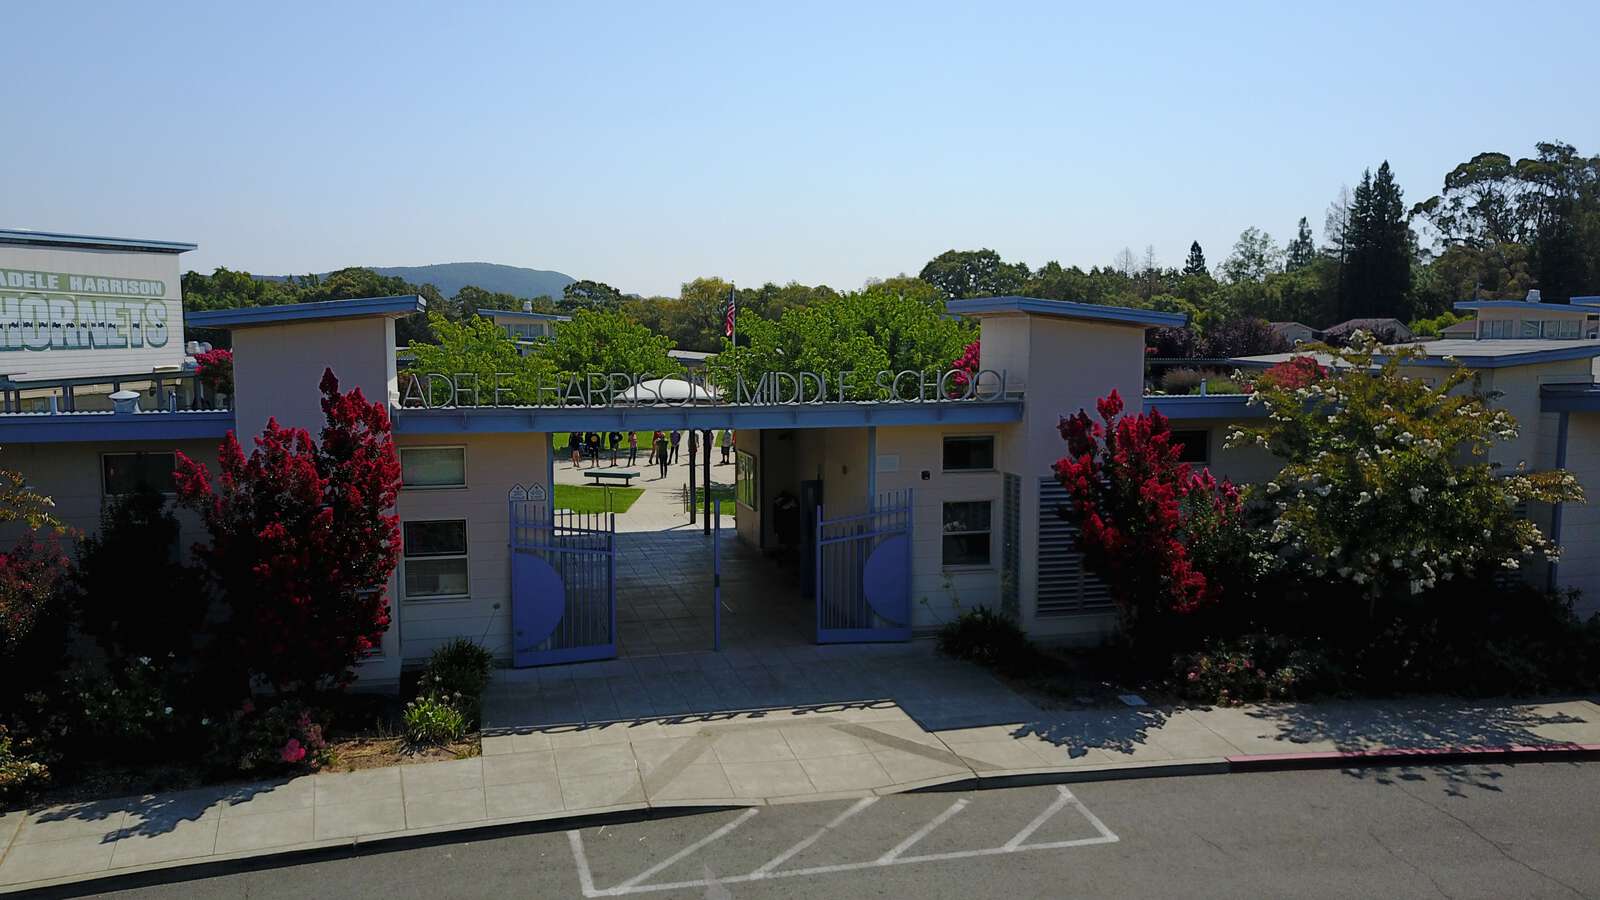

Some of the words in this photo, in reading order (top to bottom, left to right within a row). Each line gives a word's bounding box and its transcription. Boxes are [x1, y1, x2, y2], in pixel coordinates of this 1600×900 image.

[69, 276, 162, 296] HARRISON
[0, 297, 168, 350] HORNETS
[402, 373, 516, 409] ADELE
[537, 372, 718, 408] HARRISON
[736, 371, 858, 406] MIDDLE
[875, 369, 1015, 404] SCHOOL
